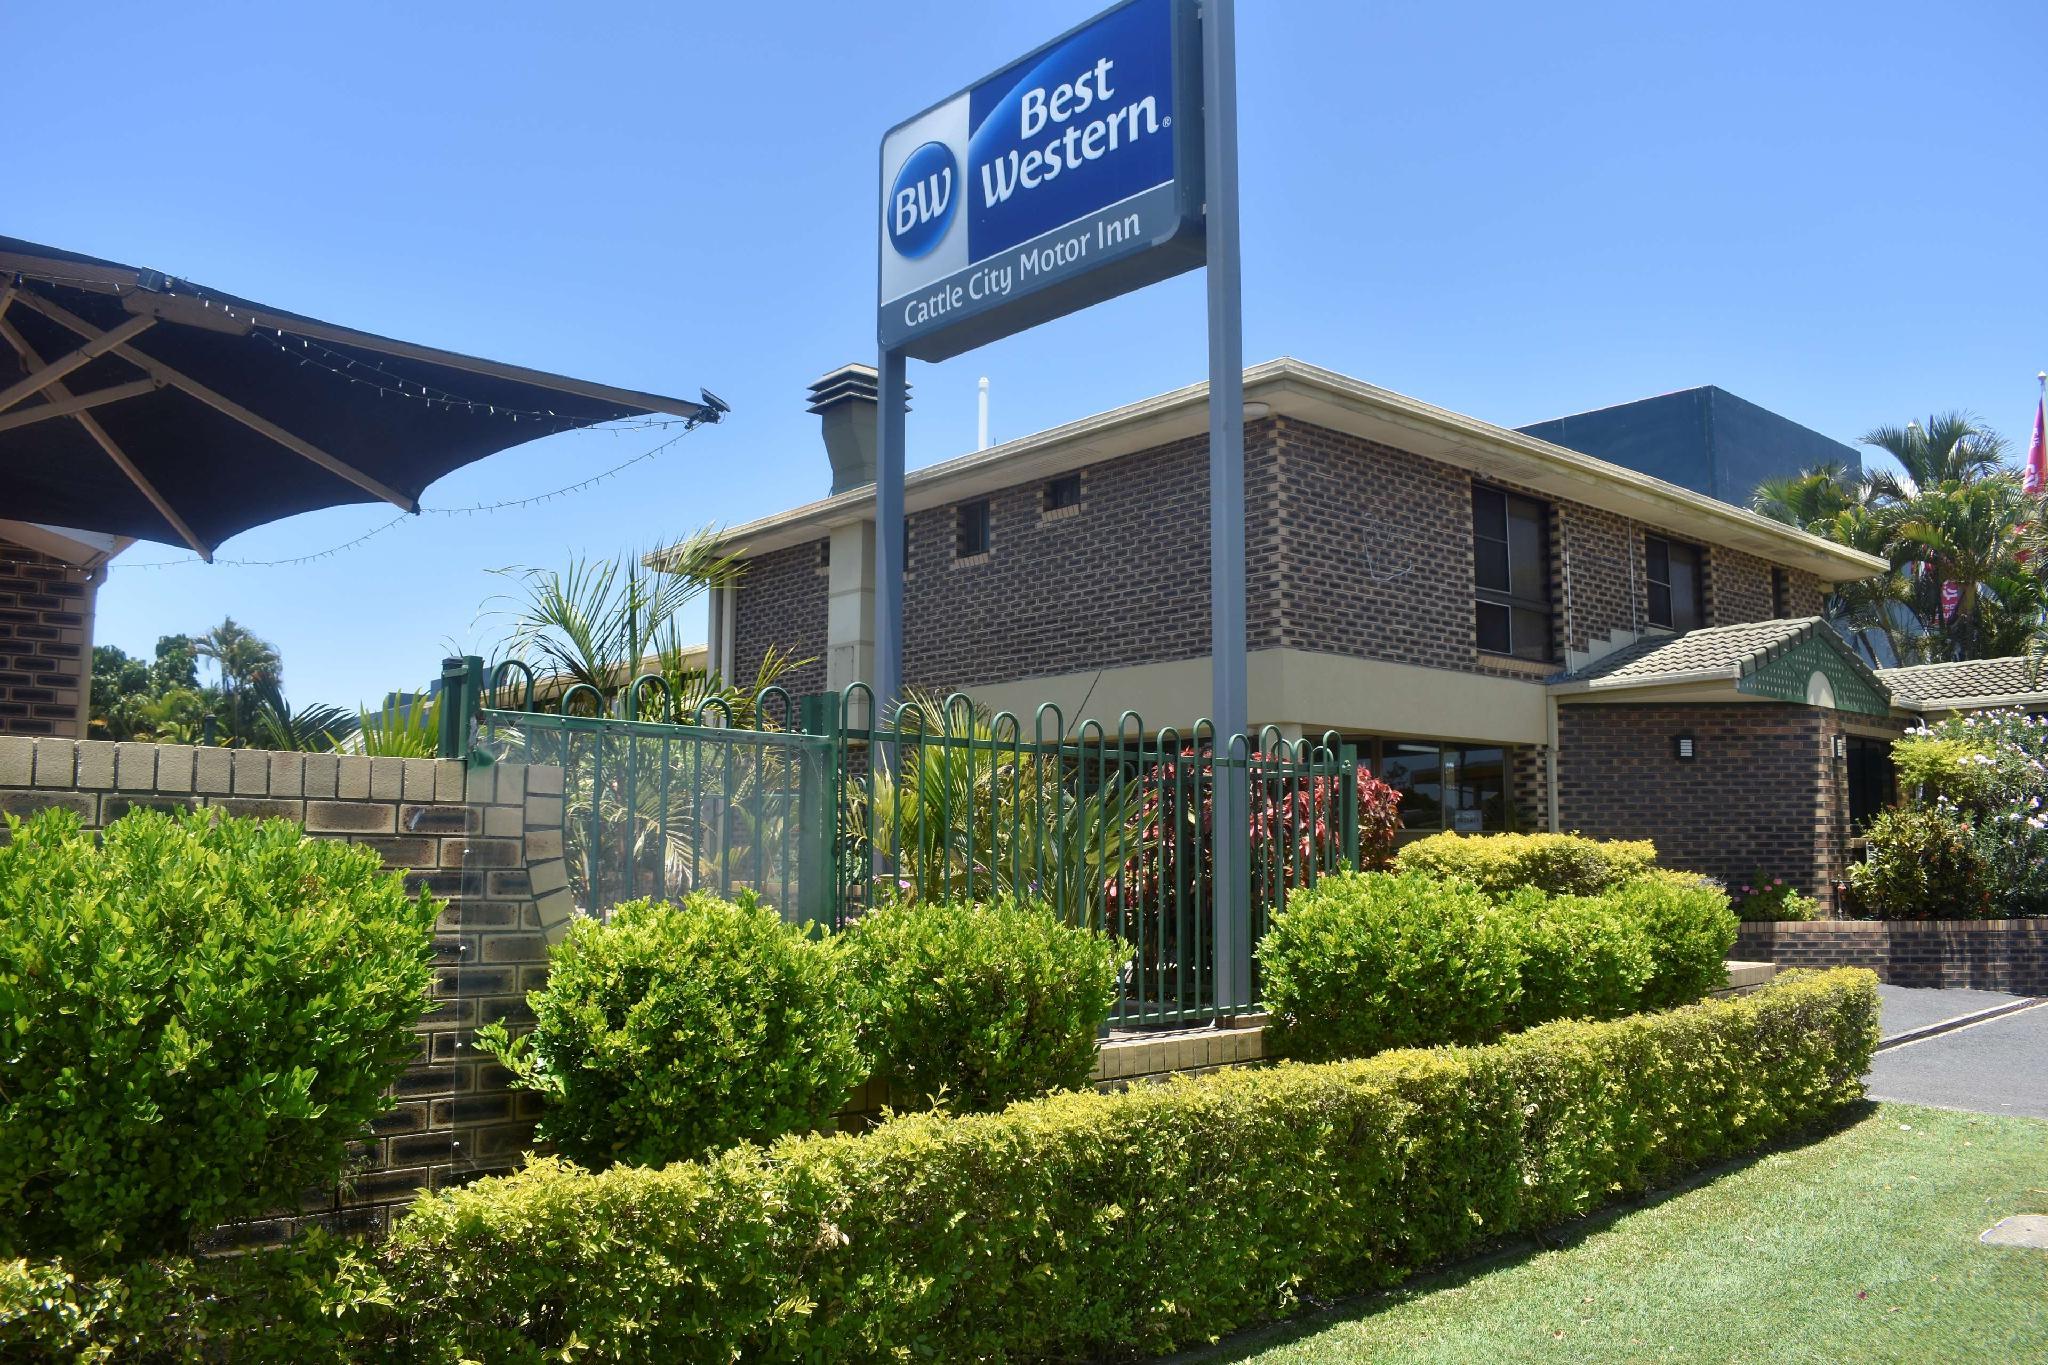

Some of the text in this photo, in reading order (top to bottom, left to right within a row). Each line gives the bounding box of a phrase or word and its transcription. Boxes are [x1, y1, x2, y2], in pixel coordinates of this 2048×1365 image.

[1020, 57, 1115, 140] Best
[895, 167, 952, 236] BW
[904, 213, 1141, 327] Cattle City Motor Inn
